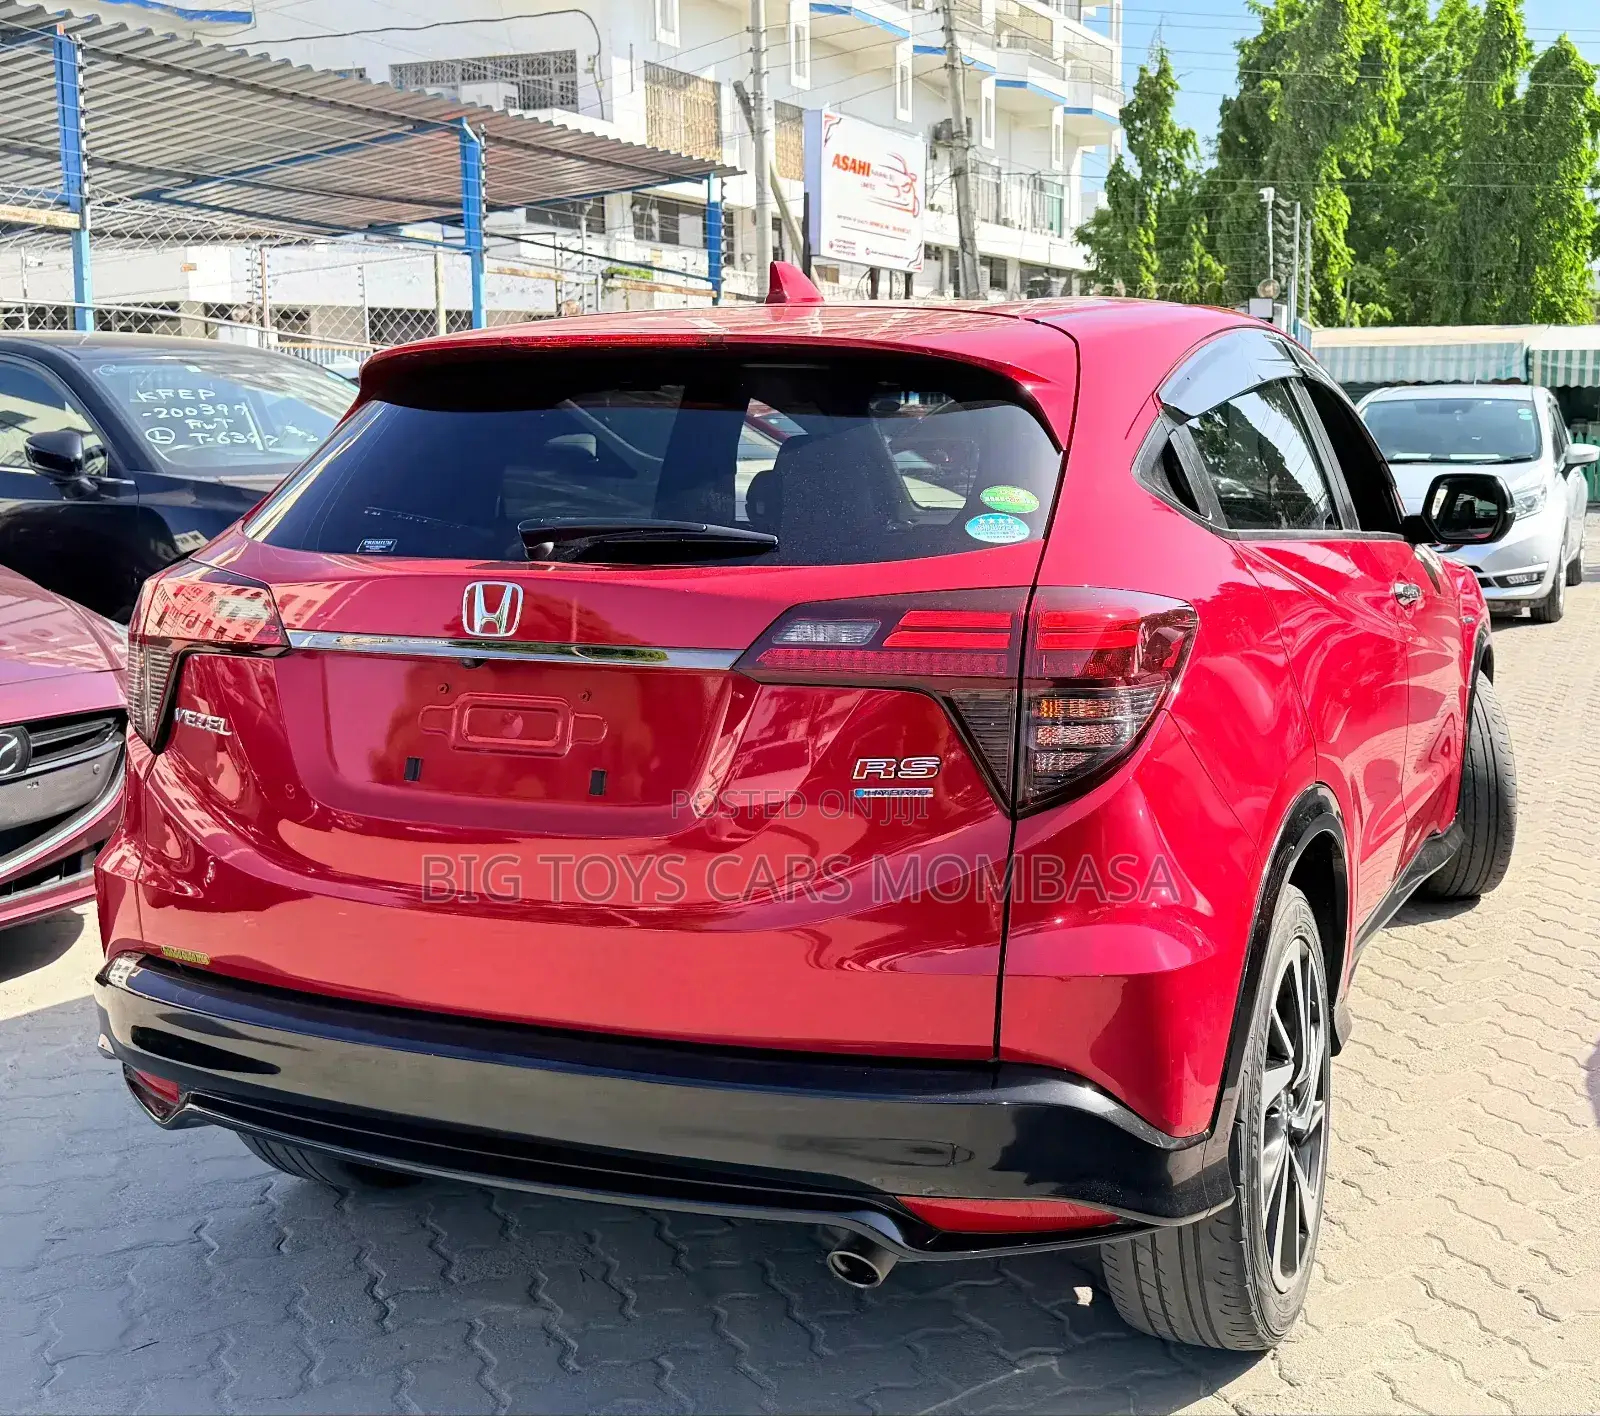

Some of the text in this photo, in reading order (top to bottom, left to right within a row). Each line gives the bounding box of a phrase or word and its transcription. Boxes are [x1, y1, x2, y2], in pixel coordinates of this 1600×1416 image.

[831, 153, 872, 177] ASAHI
[174, 707, 232, 736] VEZEL
[852, 757, 940, 779] RS
